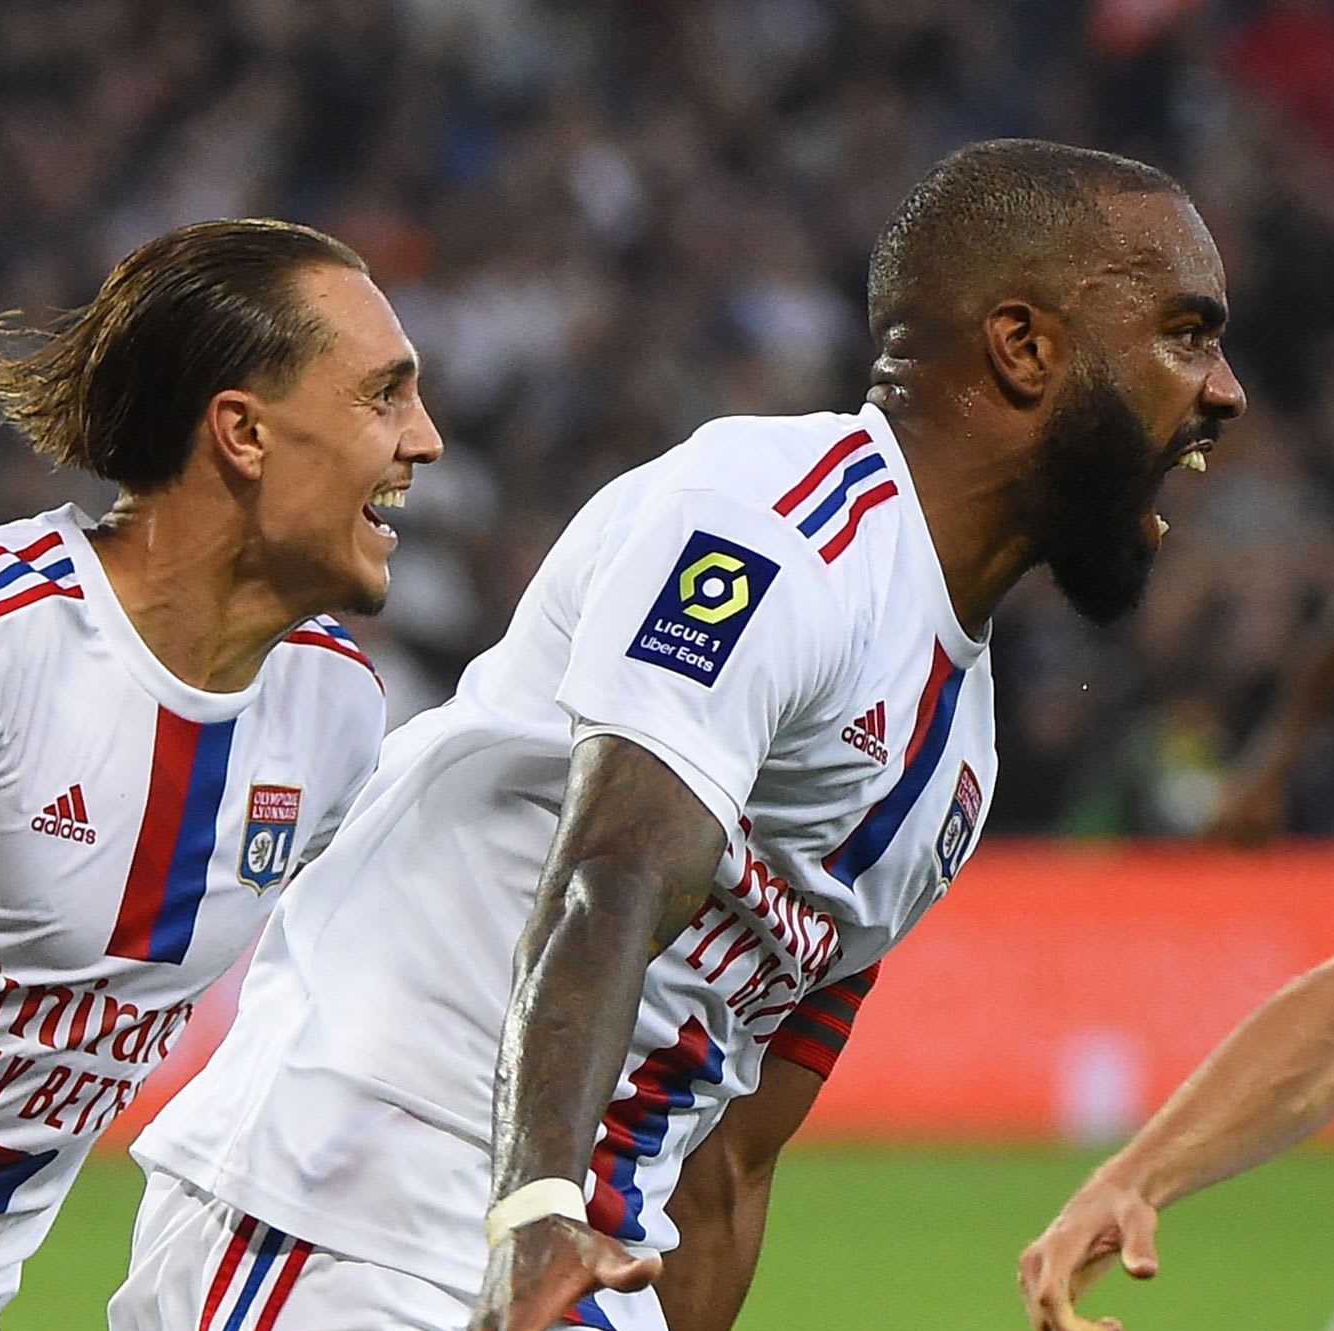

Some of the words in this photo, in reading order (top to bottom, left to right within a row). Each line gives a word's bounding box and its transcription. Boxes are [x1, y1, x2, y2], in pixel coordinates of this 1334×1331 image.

[640, 634, 677, 655] Uber
[675, 646, 714, 672] Eats
[653, 618, 709, 647] LIGUE
[711, 639, 721, 653] 1
[841, 726, 889, 766] adidas
[30, 815, 97, 845] adidas
